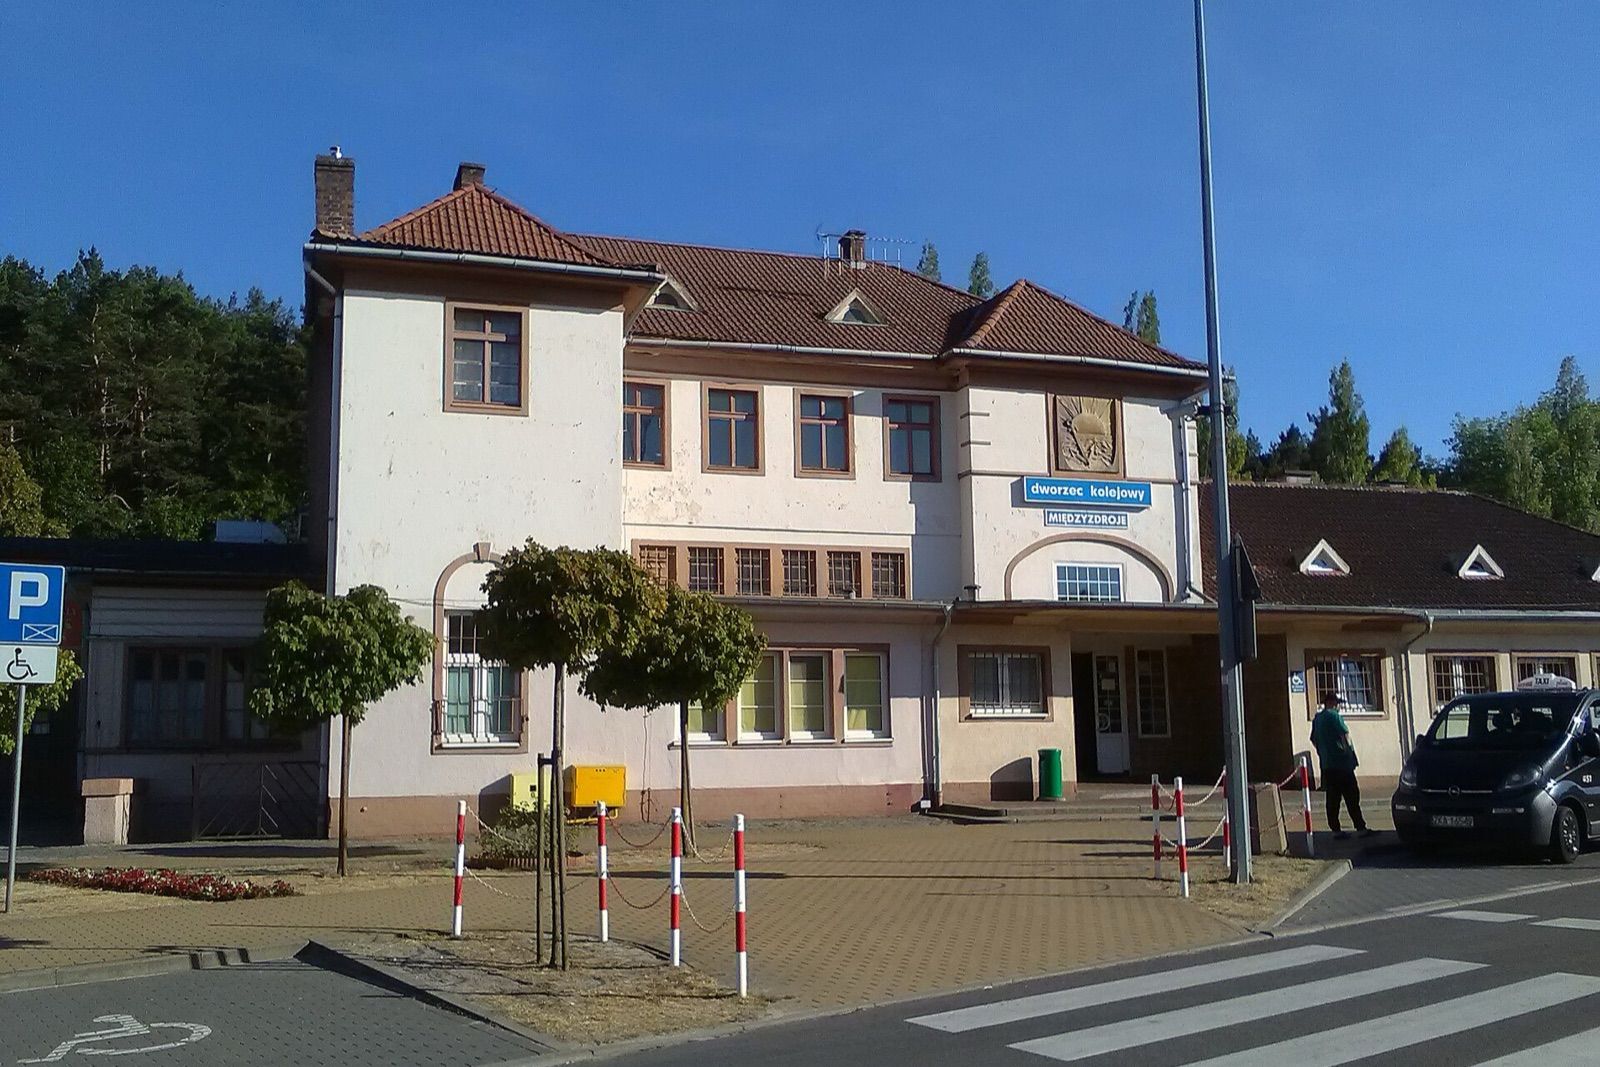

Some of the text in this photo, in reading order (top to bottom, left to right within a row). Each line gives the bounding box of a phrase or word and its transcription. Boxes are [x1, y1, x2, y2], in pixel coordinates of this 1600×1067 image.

[1031, 482, 1145, 502] dworzec kolejowy
[1048, 512, 1127, 526] MIĘDZYZDROJE
[8, 571, 49, 620] P
[1535, 677, 1550, 685] TAXI
